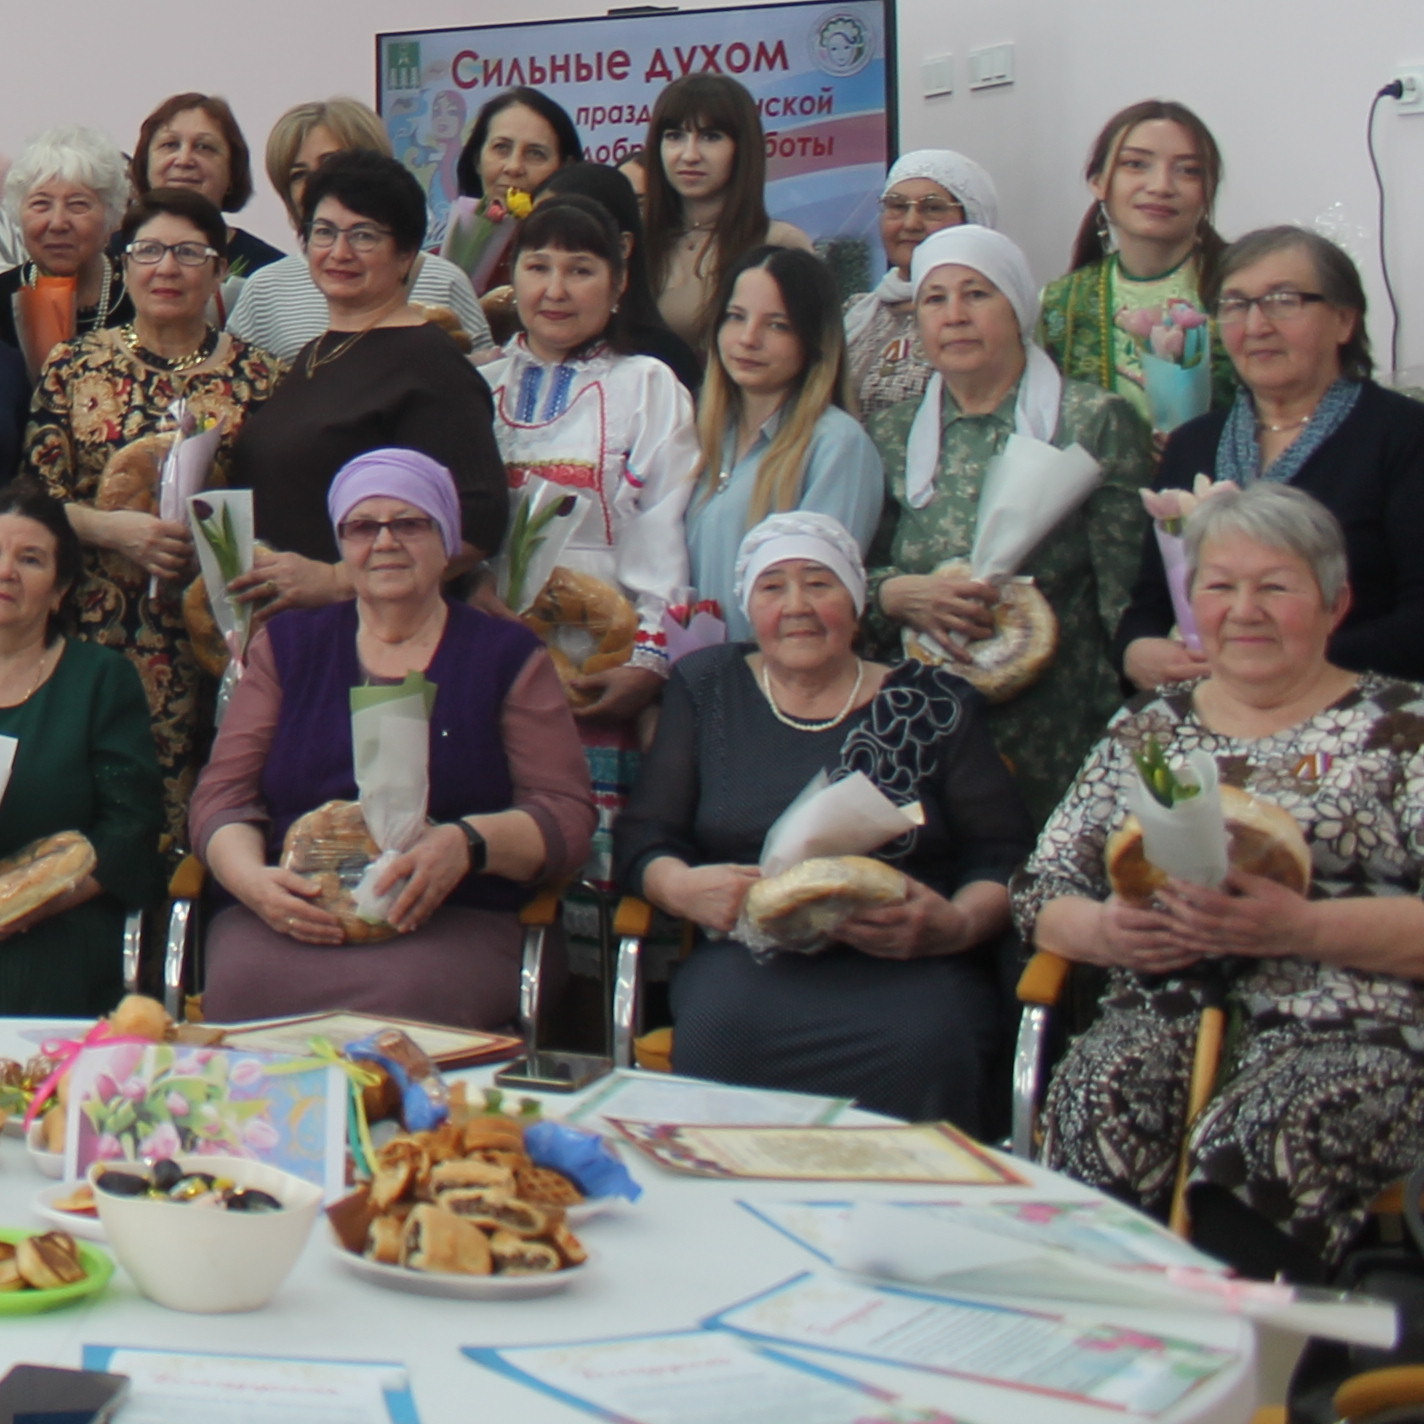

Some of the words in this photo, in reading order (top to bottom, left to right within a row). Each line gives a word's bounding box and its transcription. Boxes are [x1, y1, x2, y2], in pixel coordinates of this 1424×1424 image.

[452, 49, 631, 89] Сильные
[644, 40, 789, 83] духом
[576, 104, 653, 131] празд
[765, 131, 834, 158] боты
